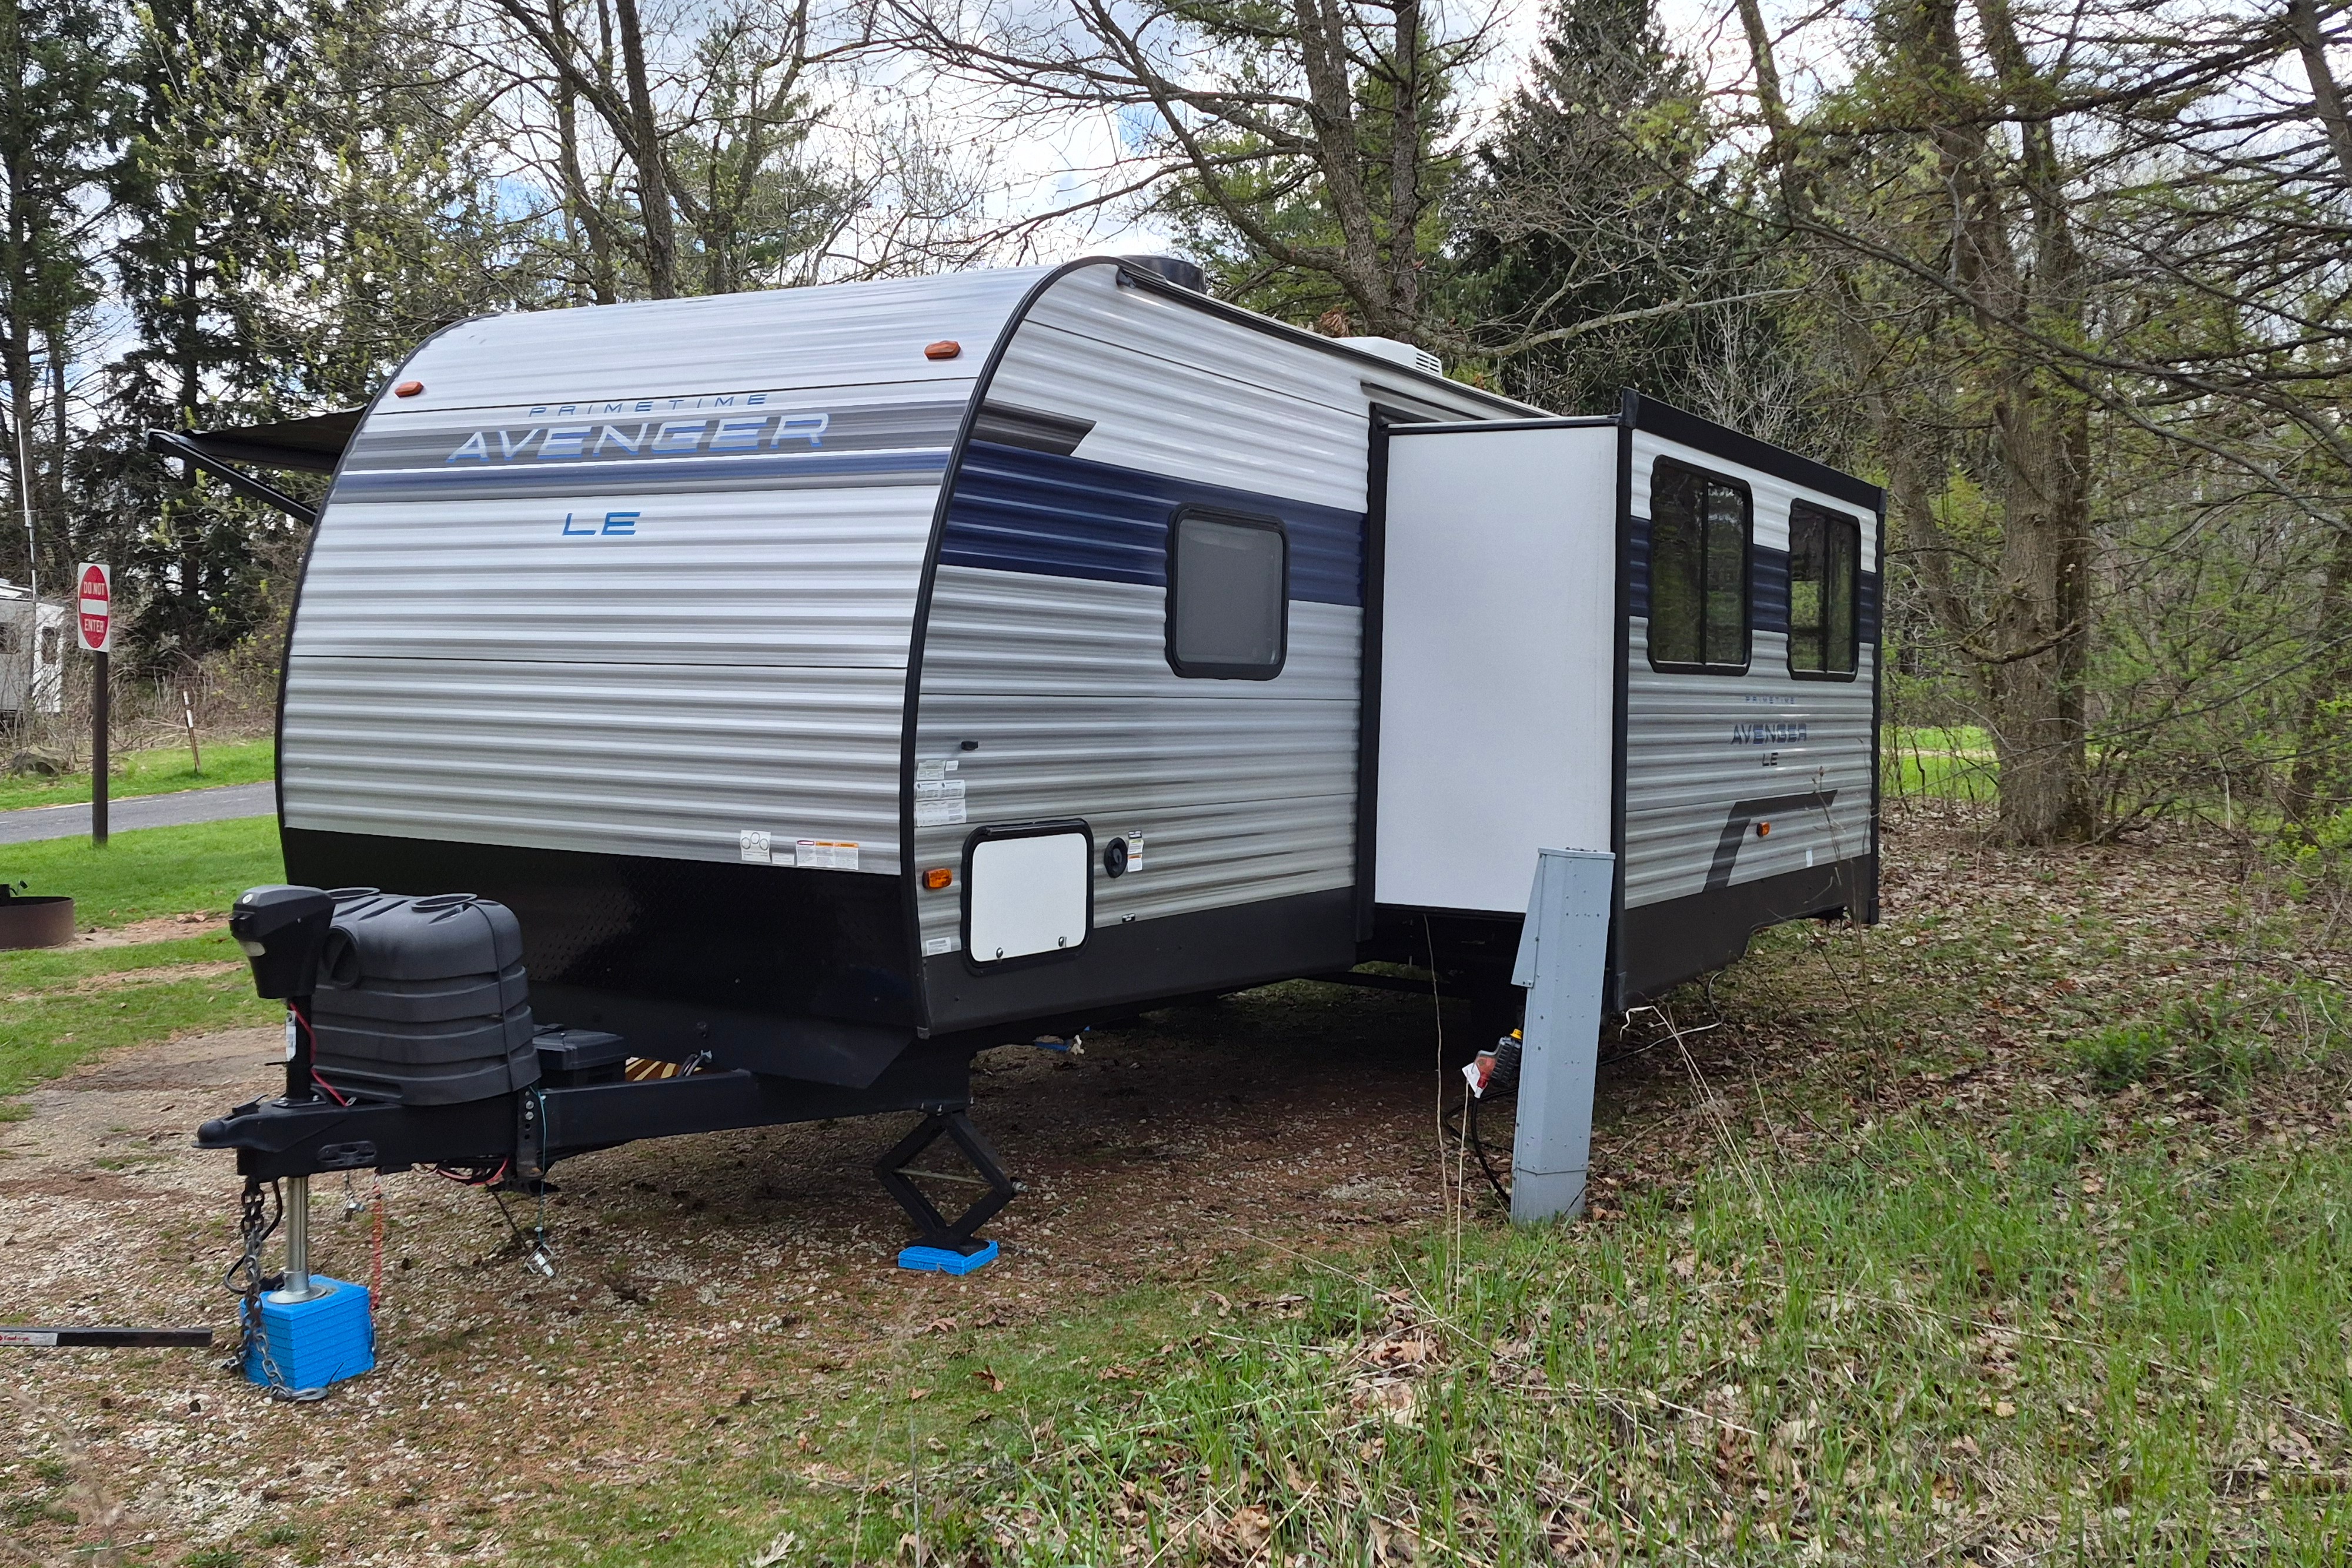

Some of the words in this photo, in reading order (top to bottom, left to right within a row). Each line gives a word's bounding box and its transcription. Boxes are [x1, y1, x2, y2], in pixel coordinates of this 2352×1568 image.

[529, 394, 767, 417] PRIMETIME
[446, 414, 828, 463] AVENGER
[562, 512, 640, 536] LE
[83, 581, 92, 594] DO
[93, 583, 105, 596] NOT
[84, 618, 105, 633] ENTER
[1730, 724, 1807, 744] AVENGER
[1762, 753, 1779, 766] LE
